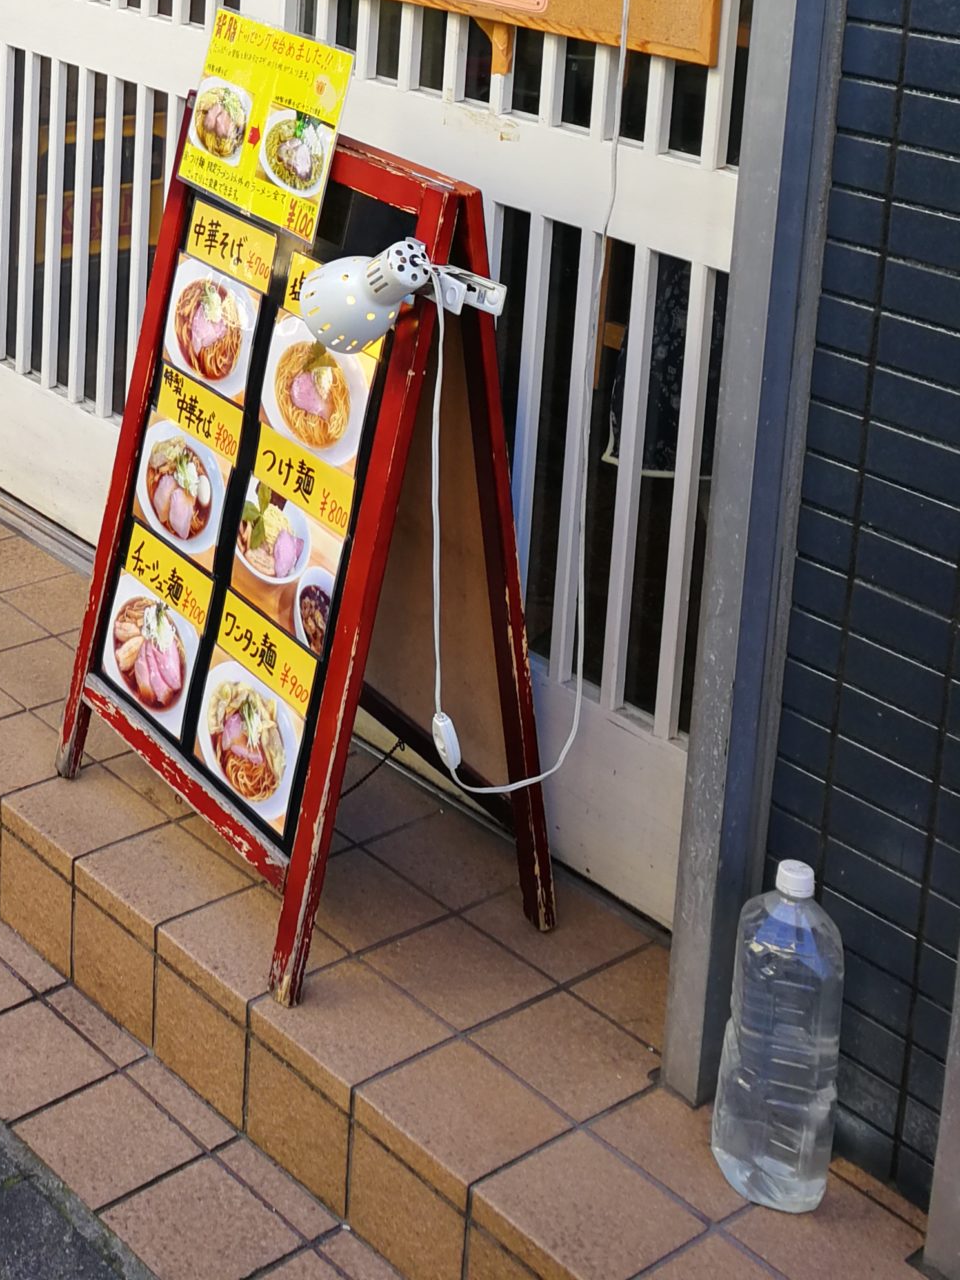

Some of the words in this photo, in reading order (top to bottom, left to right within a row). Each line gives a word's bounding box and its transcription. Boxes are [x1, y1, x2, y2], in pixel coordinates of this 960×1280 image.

[193, 216, 248, 265] 中華そば
[246, 251, 270, 280] ¥700
[285, 197, 314, 238] ¥100
[163, 368, 184, 398] 特製
[176, 393, 216, 440] 中華そば
[214, 422, 237, 457] ¥880
[262, 449, 315, 503] つけ麺
[320, 488, 348, 529] ¥800
[131, 541, 183, 609] チャーシュー麺
[182, 589, 205, 625] ¥900
[224, 611, 277, 676] ワンタン麺
[279, 663, 309, 703] ¥900
